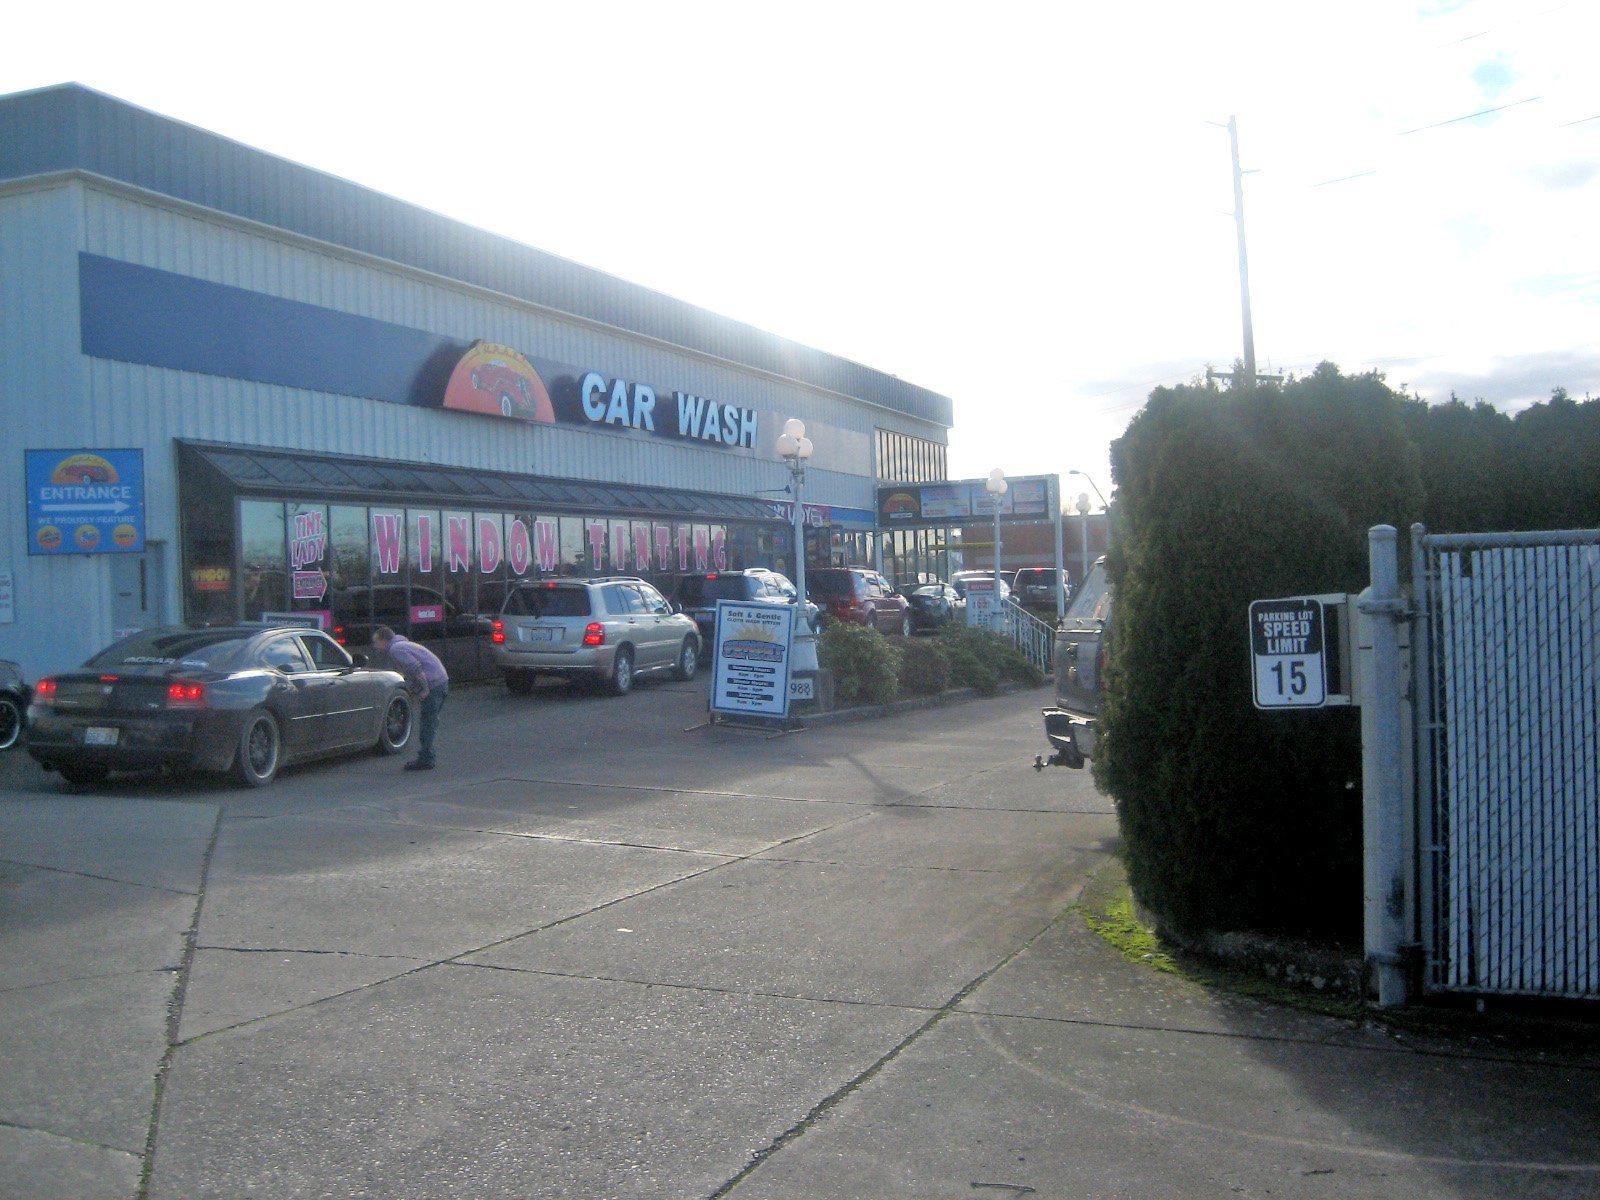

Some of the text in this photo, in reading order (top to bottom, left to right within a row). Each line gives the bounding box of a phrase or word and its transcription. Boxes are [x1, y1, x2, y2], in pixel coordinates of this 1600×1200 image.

[581, 372, 758, 448] CAR WASH
[40, 486, 132, 500] ENTRANCE
[54, 516, 95, 524] PROUDLY
[96, 515, 136, 523] FEATURE
[295, 510, 322, 539] TINT
[291, 533, 326, 570] LADY
[373, 514, 727, 575] WINDOW TINTING
[728, 610, 743, 618] Soft
[755, 612, 781, 620] Gentle
[1258, 611, 1314, 622] PARKING LOT
[1263, 621, 1310, 637] SPEED
[1267, 638, 1308, 654] LIMIT
[1271, 661, 1307, 695] 15
